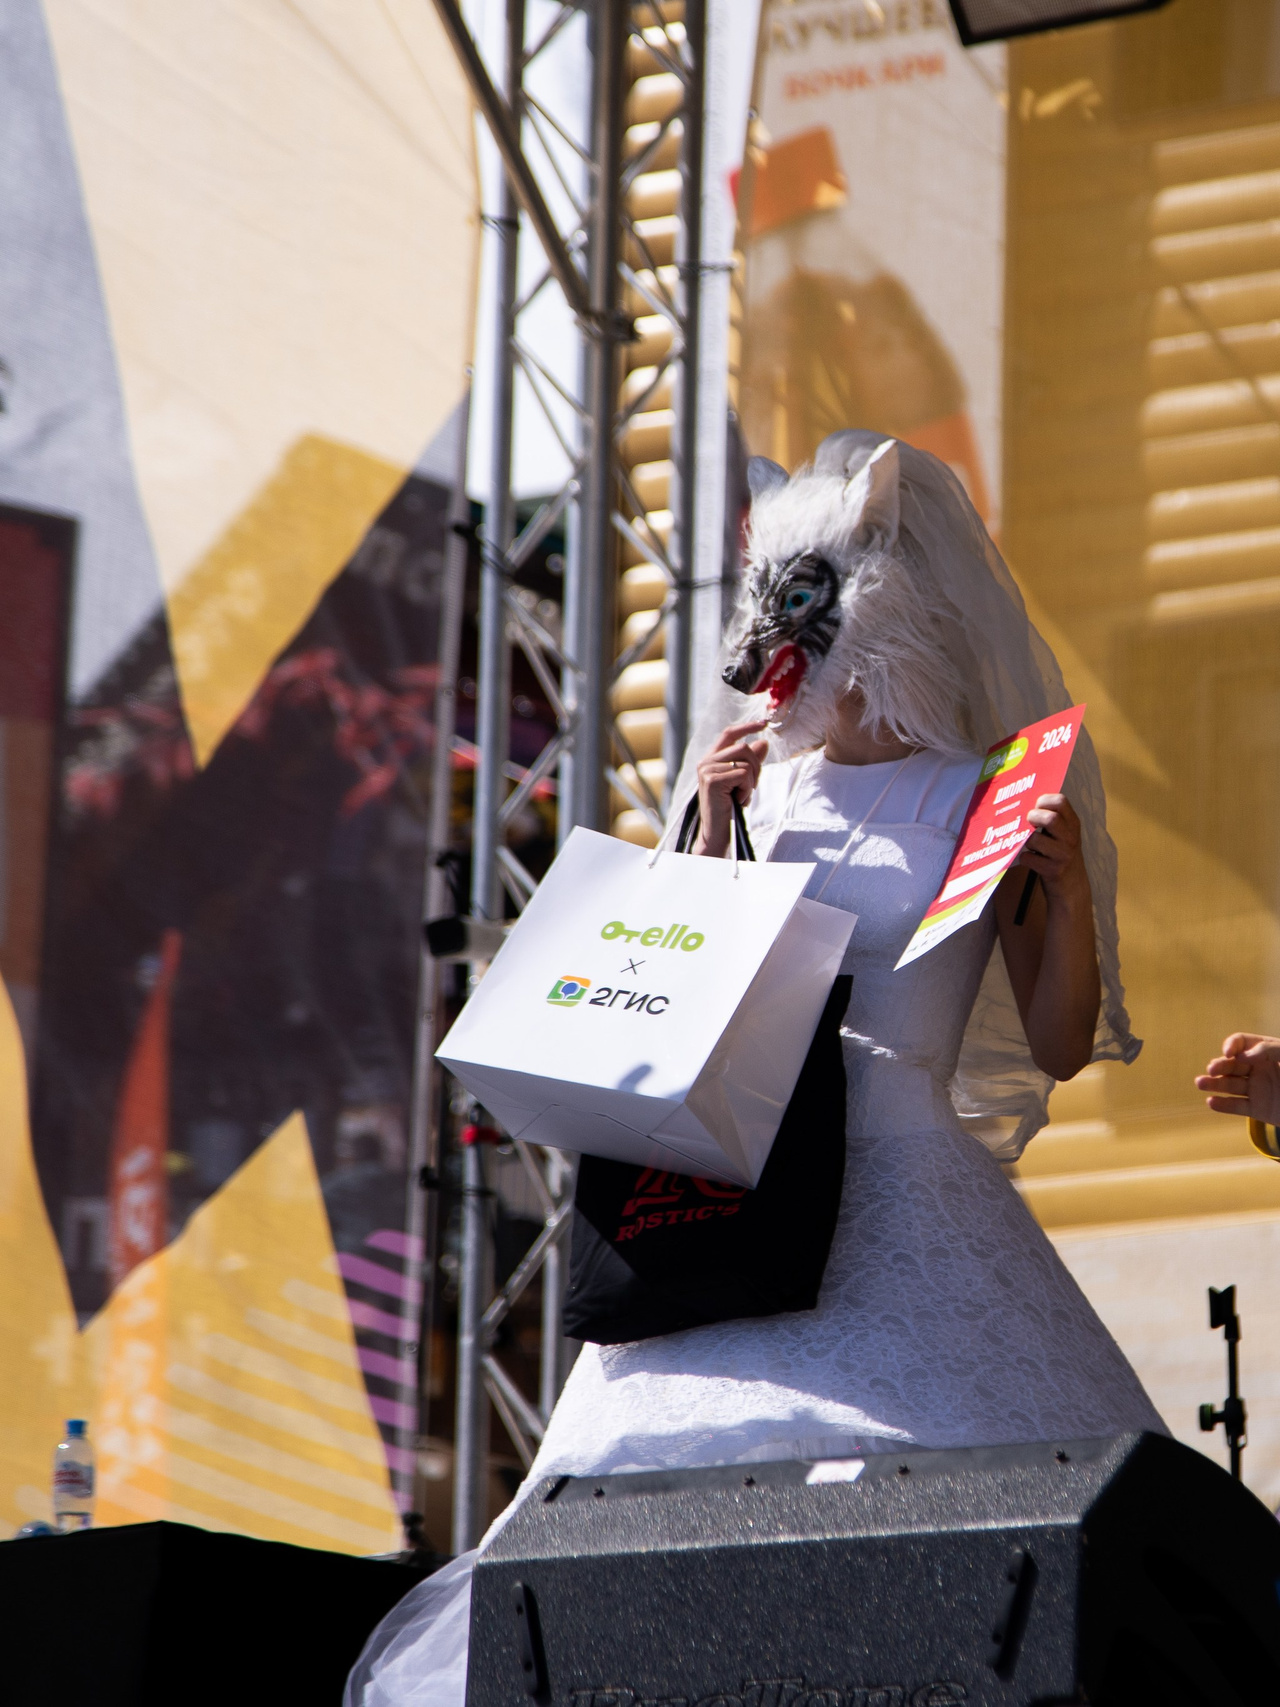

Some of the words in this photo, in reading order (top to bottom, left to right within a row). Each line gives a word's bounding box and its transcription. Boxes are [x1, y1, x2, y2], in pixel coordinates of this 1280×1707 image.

[1038, 723, 1072, 754] 2024
[993, 773, 1036, 805] ДИПЛОМ
[589, 987, 670, 1015] 2ГИС
[614, 1203, 741, 1241] ROSTIC'S
